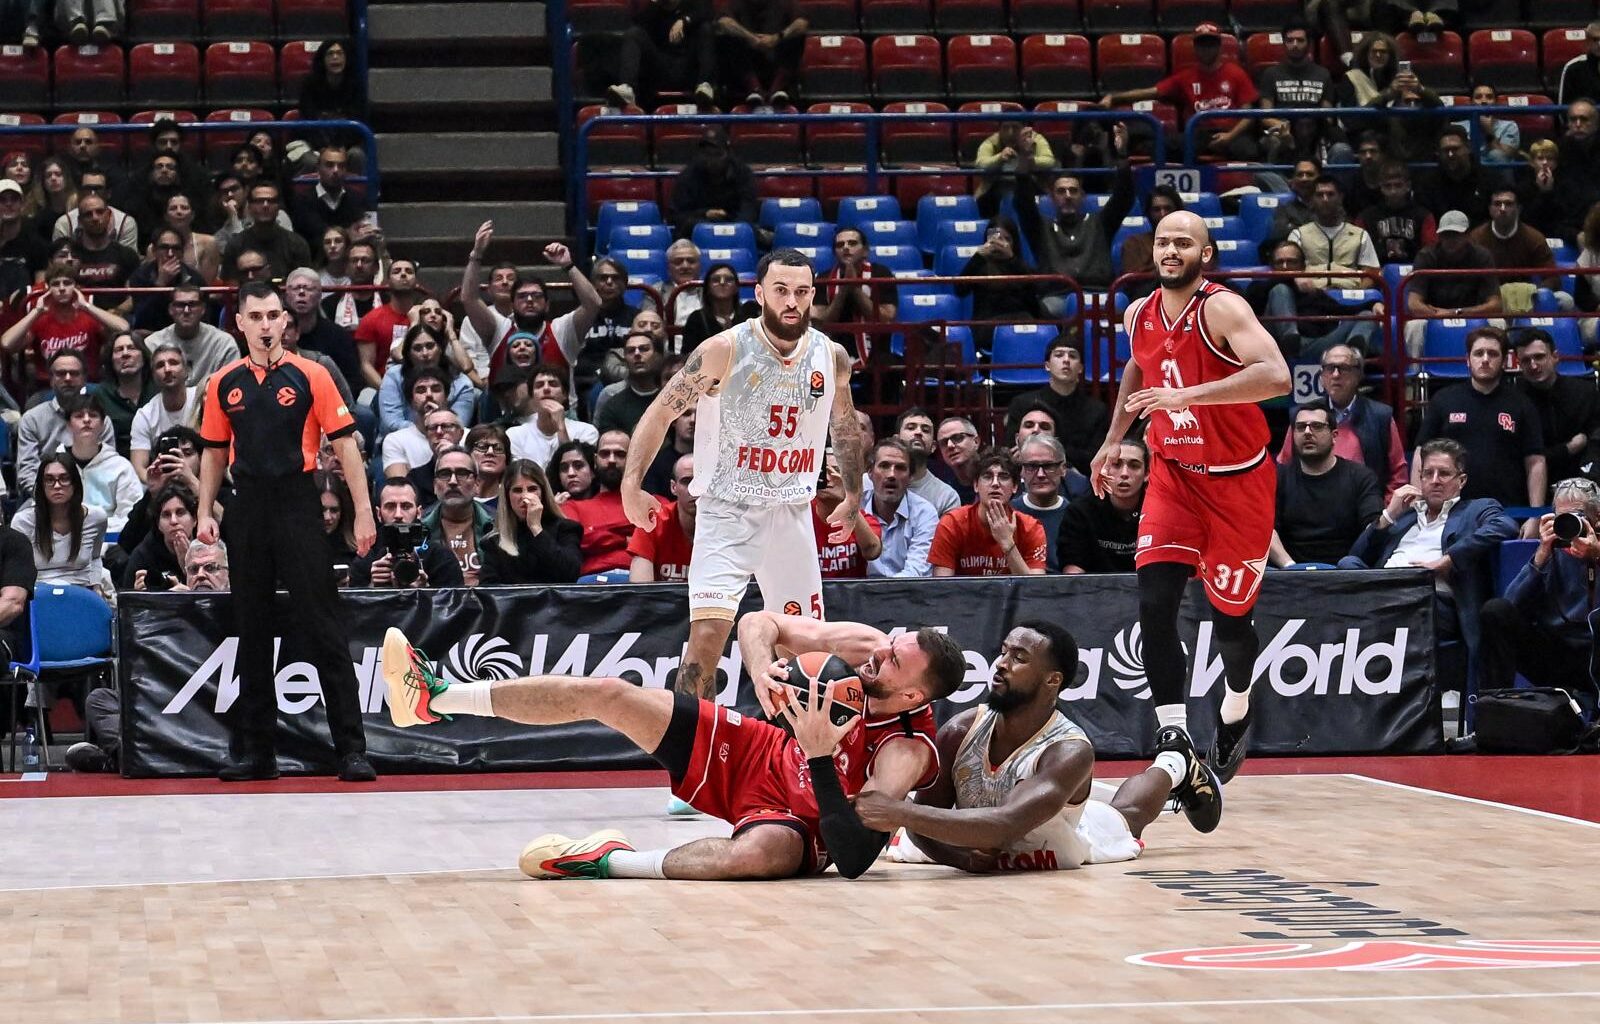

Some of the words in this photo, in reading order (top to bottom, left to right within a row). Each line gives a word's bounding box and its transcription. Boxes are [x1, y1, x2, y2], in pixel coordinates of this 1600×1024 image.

[1162, 173, 1193, 193] 30
[767, 404, 799, 439] 55
[736, 446, 815, 475] FEDCOM
[734, 483, 806, 499] zondacypto
[818, 543, 857, 558] IMPIA
[960, 555, 993, 568] OLIMPIA
[660, 563, 690, 579] OLI
[1214, 563, 1245, 596] 31
[1189, 618, 1409, 697] World
[161, 636, 438, 715] Medi
[529, 632, 744, 707] Word
[1124, 868, 1471, 939] EuroLeague
